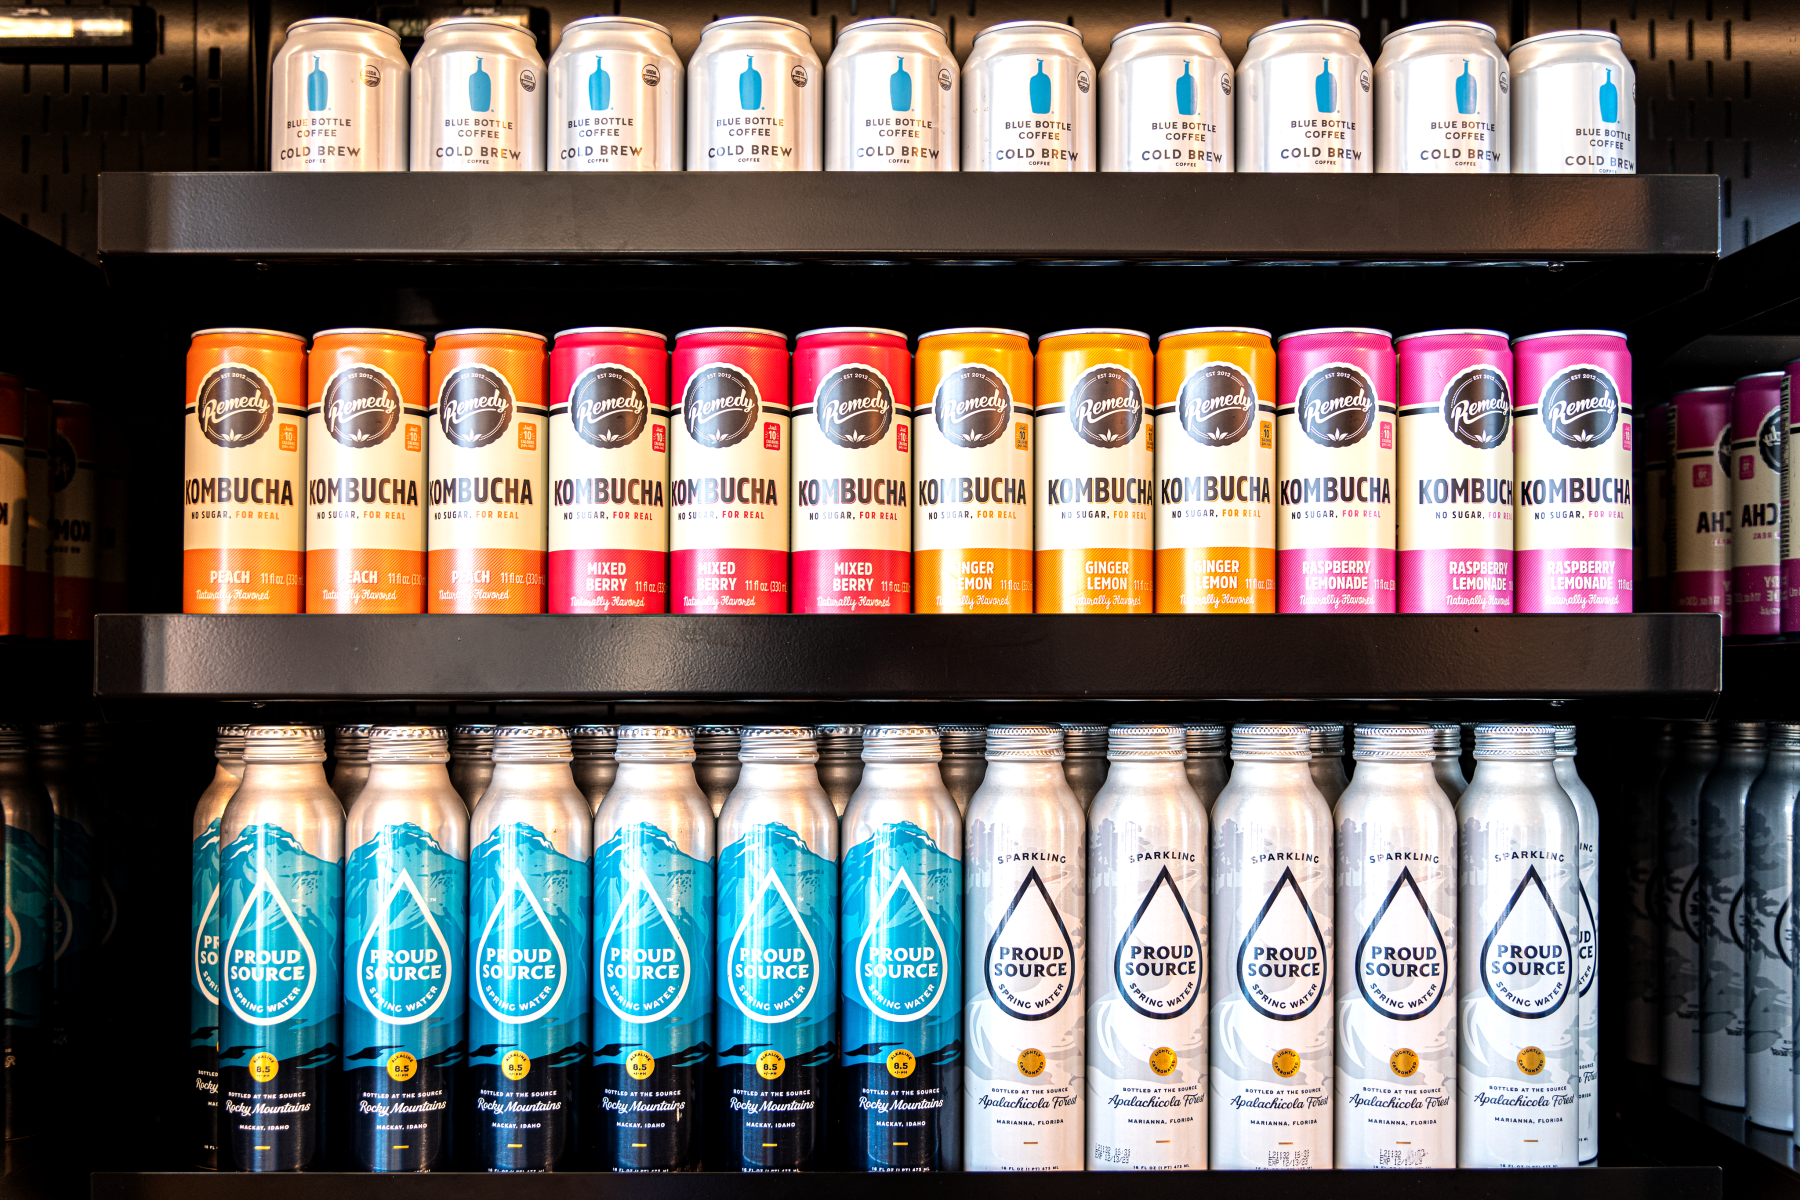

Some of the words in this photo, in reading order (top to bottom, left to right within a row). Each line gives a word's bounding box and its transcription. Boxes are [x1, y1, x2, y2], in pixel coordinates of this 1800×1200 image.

[287, 119, 308, 129] BLUE
[312, 118, 351, 127] BOTTLE
[568, 118, 590, 128] BLUE
[594, 118, 634, 126] BOTTLE
[866, 118, 891, 127] BLUE
[895, 118, 932, 129] BOTTLE
[1291, 120, 1317, 128] BLUE
[1322, 120, 1355, 130] BOTTLE
[297, 130, 337, 138] COFFEE
[579, 129, 620, 137] COFFEE
[879, 129, 920, 138] COFFEE
[1305, 131, 1345, 139] COFFEE
[1576, 128, 1601, 136] BLUE
[1605, 129, 1630, 141] BOTTLE
[708, 145, 743, 158] COLD
[752, 145, 792, 157] BREW
[1589, 139, 1624, 149] COFFEE
[281, 146, 311, 160] COLD
[318, 146, 361, 157] BREW
[436, 147, 473, 158] COLD
[481, 149, 521, 160] BREW
[561, 146, 594, 160] COLD
[600, 145, 642, 156] BREW
[857, 146, 894, 157] COLD
[901, 146, 939, 160] BREW
[996, 148, 1034, 160] COLD
[1042, 148, 1078, 161] BREW
[1142, 149, 1181, 160] COLD
[1189, 150, 1222, 163] BREW
[1281, 147, 1321, 159] COLD
[1328, 147, 1361, 161] BREW
[1420, 148, 1461, 160] COLD
[1468, 149, 1500, 162] BREW
[1565, 155, 1604, 166] COLD
[1610, 157, 1634, 171] BREW
[202, 389, 270, 432] Remedy
[329, 390, 396, 433] Remedy
[443, 389, 509, 433] Remedy
[577, 390, 645, 432] Remedy
[688, 388, 755, 433] Remedy
[823, 390, 889, 433] Remedy
[941, 389, 1007, 432] Remedy
[1076, 390, 1140, 432] Remedy
[1185, 387, 1252, 431] Remedy
[1304, 388, 1372, 432] Remedy
[1451, 392, 1509, 433] Remedy
[1549, 390, 1616, 433] Remedy
[524, 431, 532, 440] 10
[185, 478, 294, 506] KOMBUCHA
[310, 478, 418, 506] KOMBUCHA
[429, 477, 533, 506] KOMBUCHA
[555, 478, 664, 507] KOMBUCHA
[672, 477, 778, 507] KOMBUCHA
[799, 478, 907, 507] KOMBUCHA
[919, 477, 1027, 506] KOMBUCHA
[1048, 477, 1153, 506] KOMBUCHA
[1162, 476, 1271, 505] KOMBUCHA
[1281, 477, 1391, 506] KOMBUCHA
[1419, 478, 1513, 505] KOMBUCH
[1521, 478, 1631, 506] KOMBUCHA
[201, 511, 231, 519] SUGAR,
[236, 511, 253, 519] FOR
[258, 511, 279, 520] REAL
[1535, 512, 1545, 520] NO
[1550, 511, 1584, 519] SUGAR,
[1589, 510, 1604, 518] FOR
[1609, 511, 1624, 519] REAL
[588, 562, 626, 575] MIXED
[698, 562, 735, 575] MIXED
[835, 562, 872, 575] MIXED
[1085, 561, 1129, 575] GINGER
[1194, 560, 1239, 573] GINGER
[1302, 561, 1371, 575] RASPBERRY
[1449, 561, 1508, 575] RASPBERRY
[1547, 561, 1615, 574] RASPBERRY
[210, 570, 250, 584] PEACH
[338, 570, 378, 584] PEACH
[586, 578, 627, 591] BERRY
[697, 578, 737, 591] BERRY
[833, 578, 874, 591] BERRY
[1087, 577, 1127, 590] LEMON
[1196, 576, 1237, 589] LEMON
[1305, 576, 1367, 590] LEMONADE
[1452, 577, 1506, 590] LEMONADE
[1550, 577, 1613, 590] LEMONADE
[745, 580, 752, 590] 11
[754, 580, 759, 591] fl
[570, 596, 610, 611] Naturally
[611, 596, 645, 607] Flavored
[1300, 594, 1340, 609] Naturally
[1341, 594, 1374, 606] Flavored
[1129, 851, 1195, 863] SPARKLING
[1370, 852, 1439, 864] SPARKLING
[1495, 851, 1565, 863] SPARKLING
[235, 949, 301, 964] PROUD
[370, 949, 438, 964] PROUD
[487, 948, 551, 963] PROUD
[611, 948, 675, 963] PROUD
[740, 948, 805, 963] PROUD
[869, 947, 935, 962] PROUD
[1000, 946, 1064, 961] PROUD
[1131, 945, 1193, 960] PROUD
[1254, 947, 1317, 961] PROUD
[1371, 946, 1437, 961] PROUD
[1497, 945, 1562, 959] PROUD
[231, 966, 305, 981] SOURCE
[366, 964, 442, 981] SOURCE
[483, 964, 555, 980] SOURCE
[607, 964, 680, 979] SOURCE
[735, 964, 809, 979] SOURCE
[865, 962, 939, 978] SOURCE
[994, 962, 1067, 978] SOURCE
[1125, 961, 1196, 976] SOURCE
[1248, 962, 1320, 978] SOURCE
[1366, 962, 1440, 978] SOURCE
[1492, 961, 1566, 975] SOURCE
[234, 987, 263, 1013] SPRING
[267, 987, 301, 1012] WATER
[998, 983, 1032, 1009] SPRING
[1035, 983, 1064, 1008] WATER
[1496, 981, 1531, 1007] SPRING
[1534, 981, 1563, 1006] WATER
[1394, 1050, 1414, 1058] LIGHTLY
[763, 1063, 778, 1071] 8.5
[1391, 1061, 1417, 1075] CARBONATED
[733, 1089, 758, 1097] BOTTLED
[225, 1100, 251, 1117] Rocky
[251, 1102, 311, 1114] Mountains
[730, 1096, 759, 1114] Rocky
[759, 1100, 815, 1112] Mountains
[978, 1094, 1050, 1109] Apalachicola
[1052, 1094, 1078, 1109] Forest
